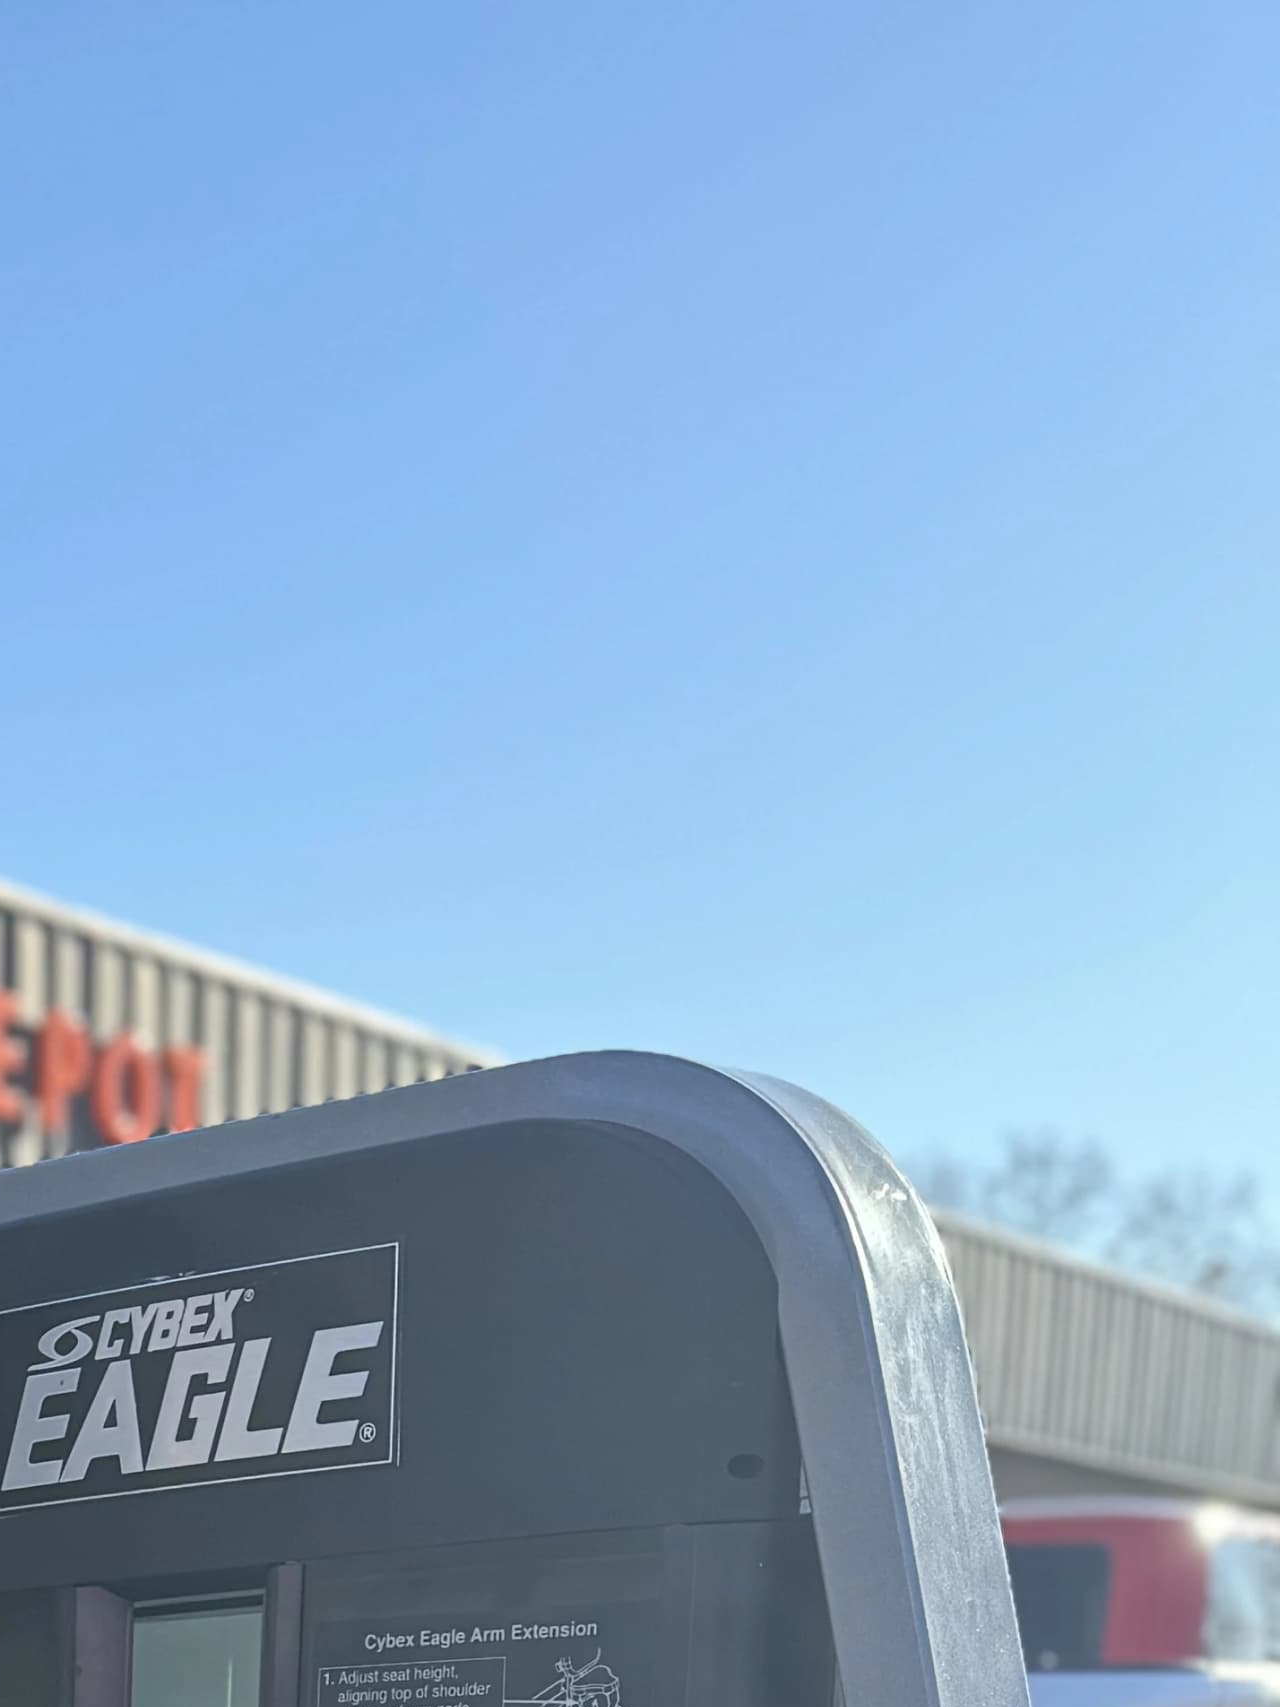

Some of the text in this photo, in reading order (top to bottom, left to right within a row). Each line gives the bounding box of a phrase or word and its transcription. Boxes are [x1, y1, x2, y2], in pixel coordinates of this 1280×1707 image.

[365, 1620, 598, 1653] Cybex Eagle Arm Extension
[323, 1665, 459, 1688] 1. Adjust seat height,
[337, 1682, 492, 1705] aligning top of shoulder
